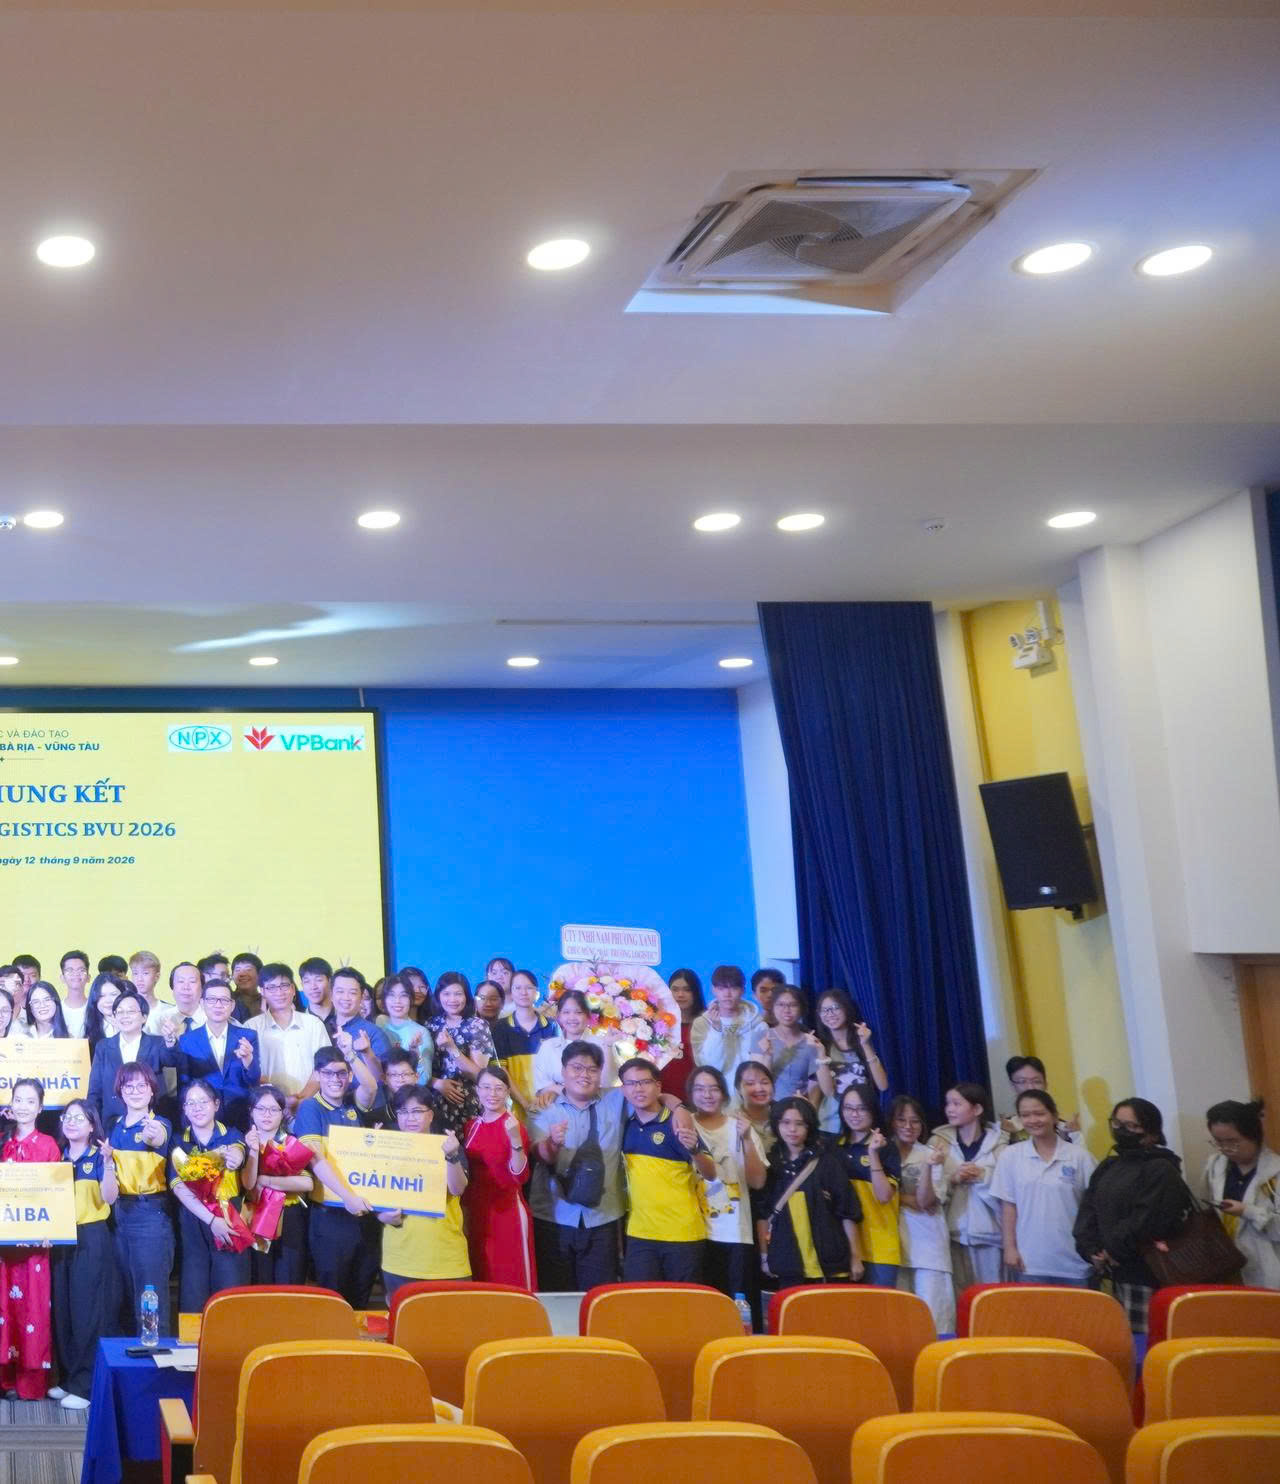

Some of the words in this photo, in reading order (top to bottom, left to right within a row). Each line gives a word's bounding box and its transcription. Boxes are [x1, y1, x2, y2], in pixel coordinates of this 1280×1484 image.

[7, 729, 21, 738] VÀ
[22, 729, 46, 738] ĐÀO
[49, 730, 69, 740] TẠO
[178, 731, 222, 745] NPX
[0, 741, 15, 751] BÀ
[17, 743, 35, 753] RỊA
[45, 741, 76, 751] VŨNG
[78, 741, 100, 751] TÀU
[280, 735, 364, 751] VPBank
[73, 777, 126, 803] KẾT
[82, 822, 125, 837] BVU
[128, 822, 176, 837] 2026
[25, 856, 36, 865] 12
[40, 855, 71, 868] tháng
[73, 856, 80, 865] 9
[81, 855, 105, 865] năm
[107, 856, 135, 865] 2026
[349, 1169, 386, 1189] GIẢI
[391, 1174, 424, 1192] NHÌ
[25, 1207, 50, 1221] BA
